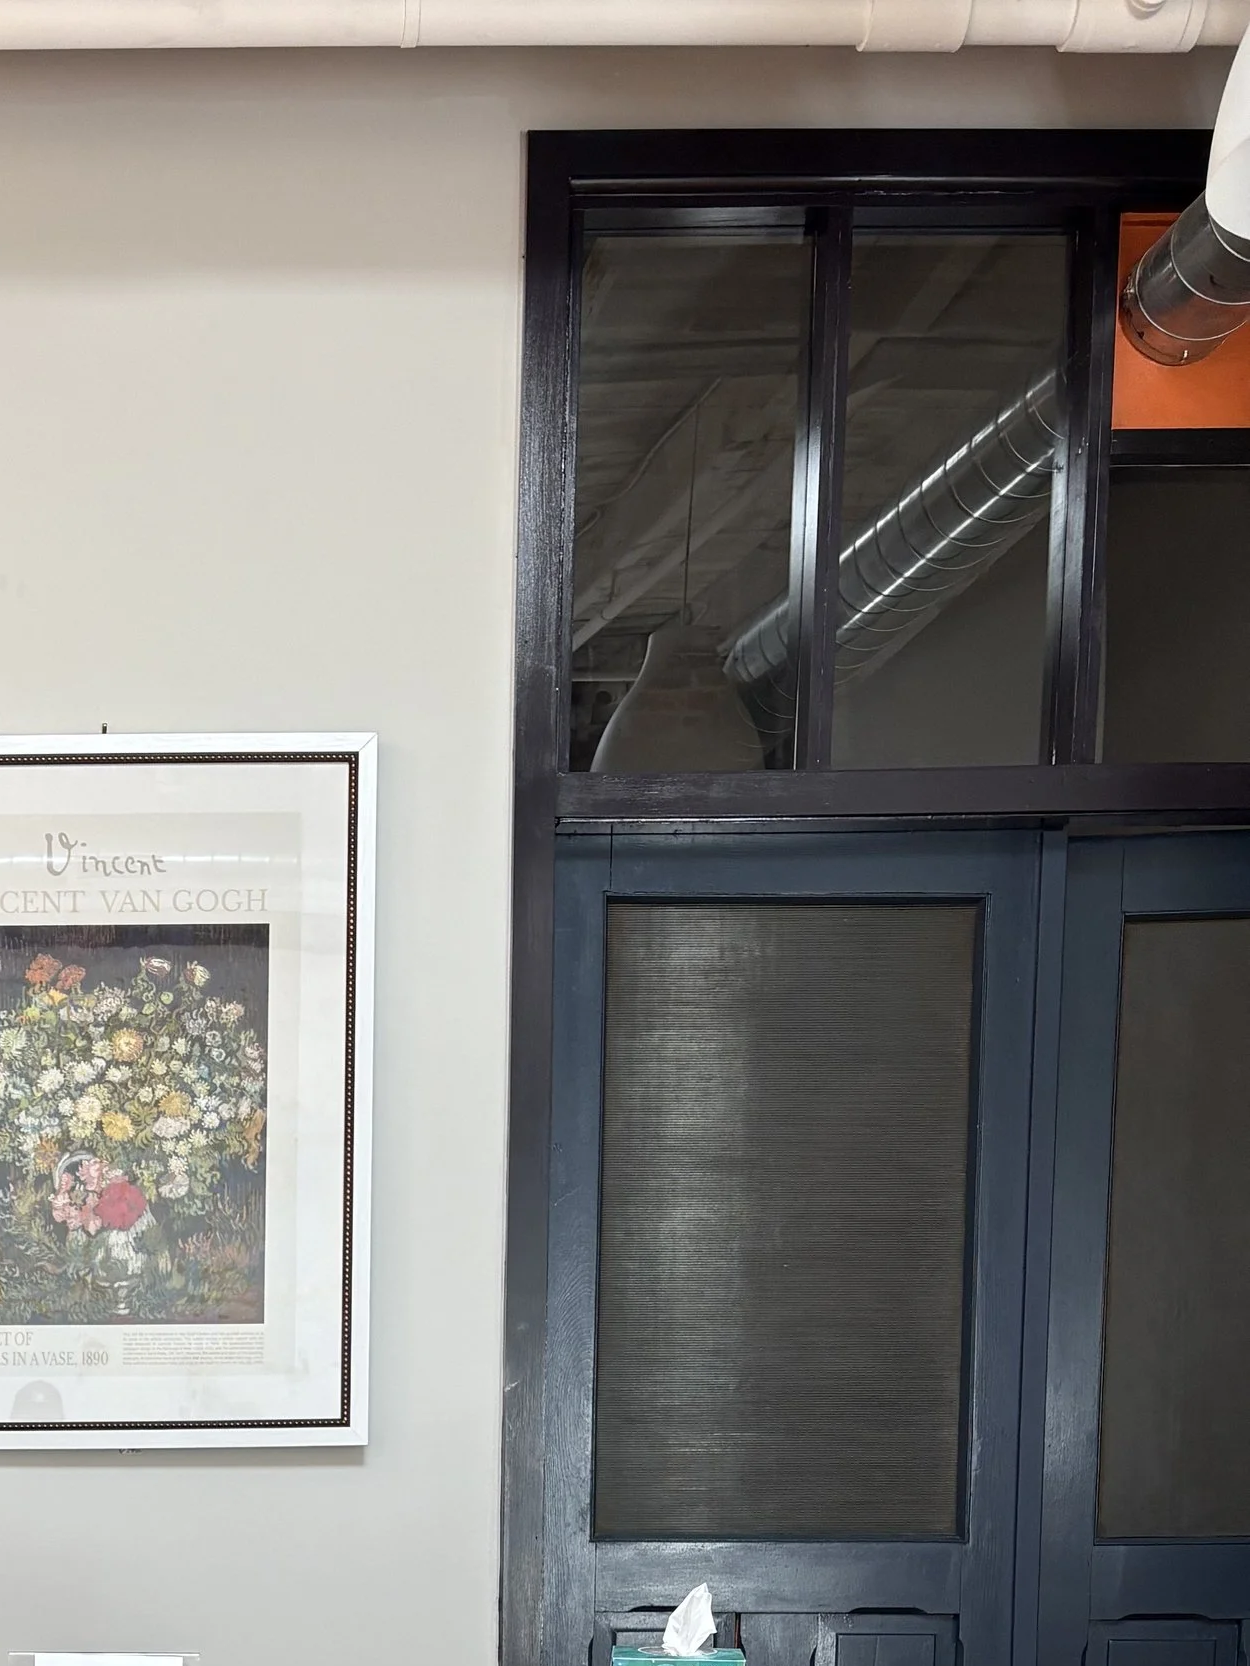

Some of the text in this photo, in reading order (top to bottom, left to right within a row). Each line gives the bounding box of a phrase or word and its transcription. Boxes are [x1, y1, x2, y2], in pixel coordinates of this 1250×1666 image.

[44, 832, 166, 876] Vincent
[99, 890, 162, 913] VAN
[172, 888, 269, 912] GOGH
[14, 1331, 34, 1346] OF
[12, 1351, 26, 1366] IN
[29, 1351, 41, 1366] A
[42, 1351, 78, 1368] VASE,
[82, 1351, 108, 1366] 1890
